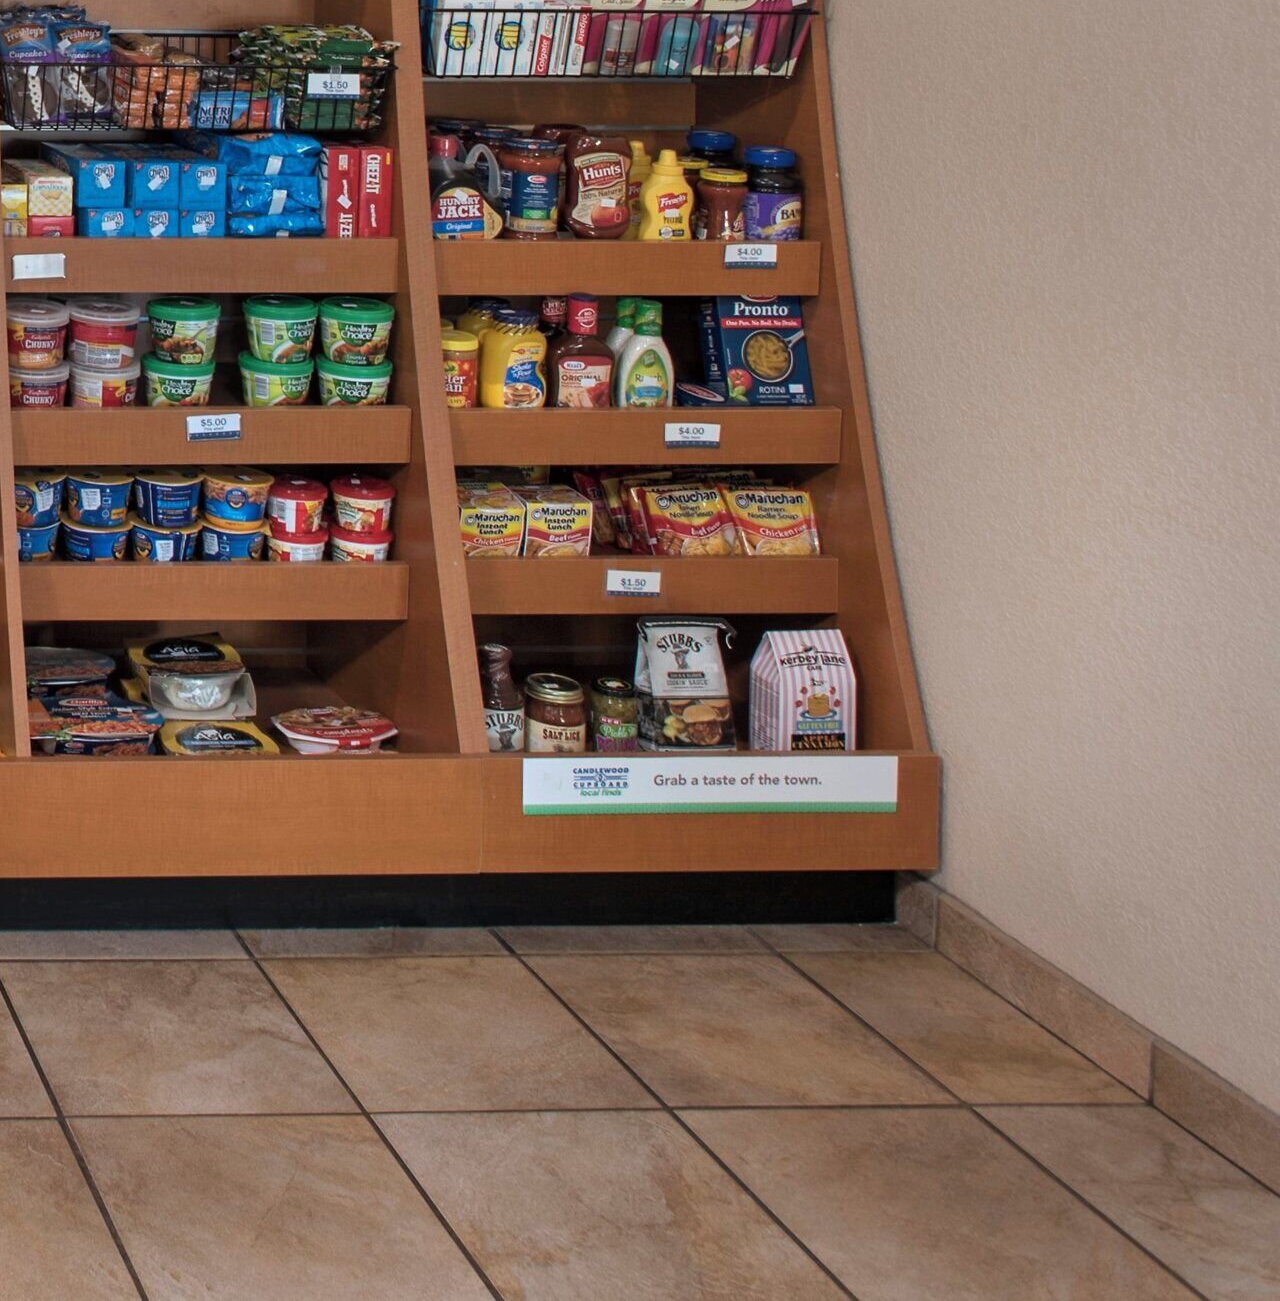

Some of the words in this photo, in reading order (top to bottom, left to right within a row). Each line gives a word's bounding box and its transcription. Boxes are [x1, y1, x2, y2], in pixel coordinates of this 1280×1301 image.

[537, 39, 551, 72] Colgate
[322, 79, 348, 90] $1.50
[437, 204, 482, 219] JACK
[446, 222, 473, 232] Original
[737, 248, 762, 256] $4.00
[733, 302, 788, 316] Pronto
[345, 324, 376, 334] Healthy
[341, 330, 372, 340] Choice
[25, 340, 55, 349] CHUNKY
[759, 386, 786, 394] ROTINI
[23, 395, 54, 405] CHUNKY
[200, 418, 227, 427] $5.00
[679, 427, 704, 435] $4.00
[747, 492, 804, 504] Maruchan
[541, 507, 587, 517] Maruchan
[747, 512, 776, 520] Noodle
[475, 513, 520, 522] Maruchan
[473, 537, 504, 546] Chicken
[549, 534, 567, 543] Beef
[620, 578, 646, 587] $1.50
[542, 729, 564, 740] SALT
[653, 774, 687, 786] Grab
[690, 777, 699, 786] a
[703, 776, 737, 786] taste
[740, 774, 755, 786] of
[757, 774, 781, 785] the
[784, 775, 823, 786] town.
[580, 789, 600, 797] local
